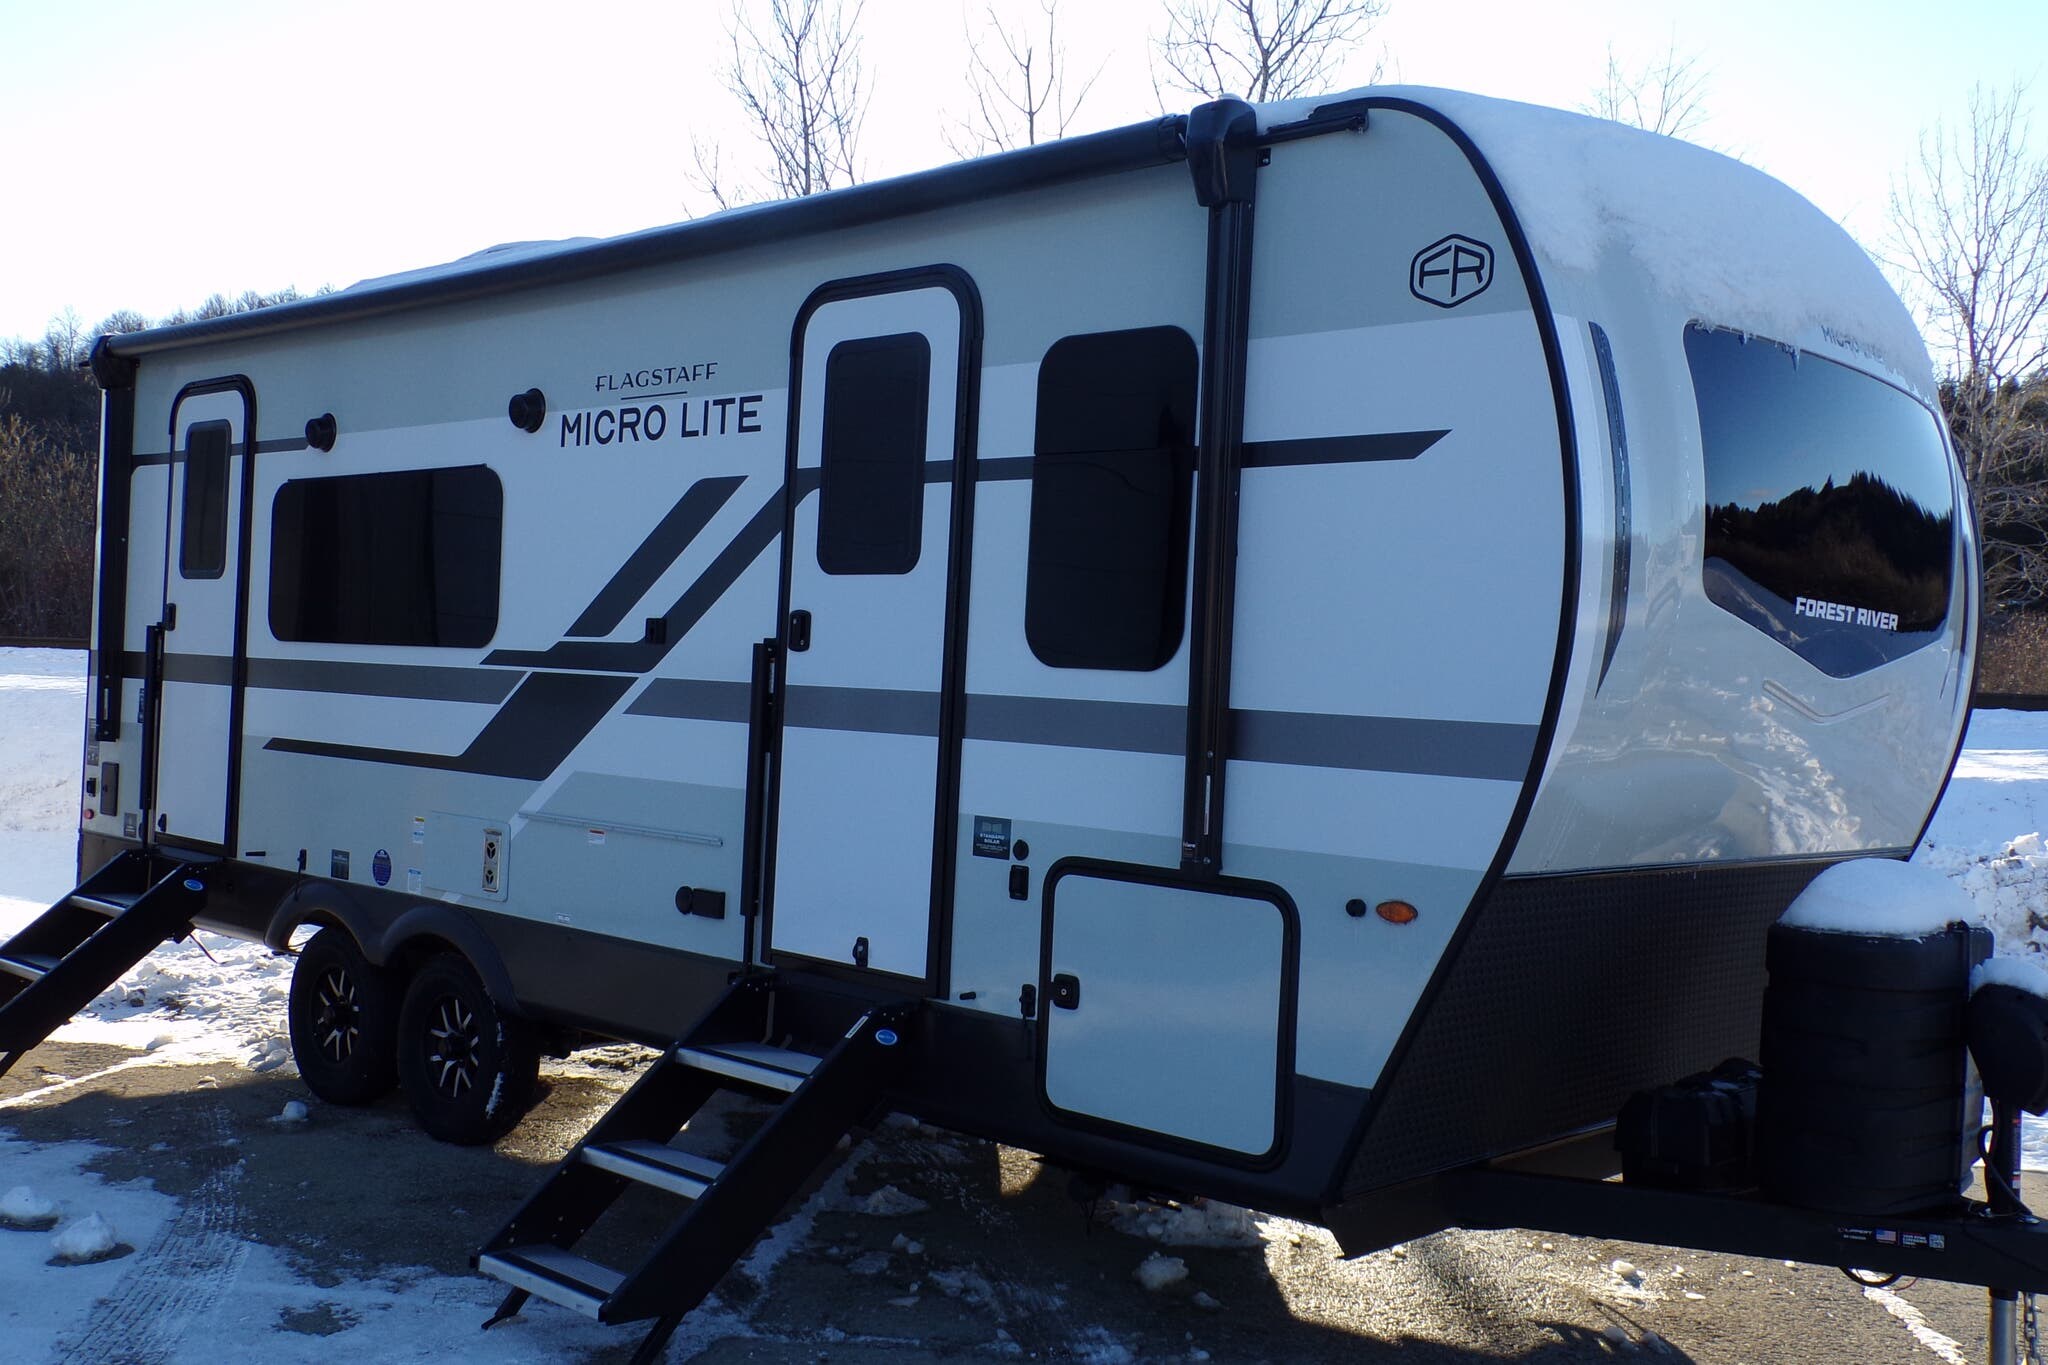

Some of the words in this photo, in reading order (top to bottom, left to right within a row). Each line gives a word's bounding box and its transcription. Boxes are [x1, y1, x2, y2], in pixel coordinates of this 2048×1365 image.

[595, 362, 719, 392] FLAGSTAFF
[560, 404, 667, 448] MICRO
[680, 394, 764, 438] LITE
[1795, 596, 1856, 623] FOREST
[1857, 607, 1899, 631] RIVER
